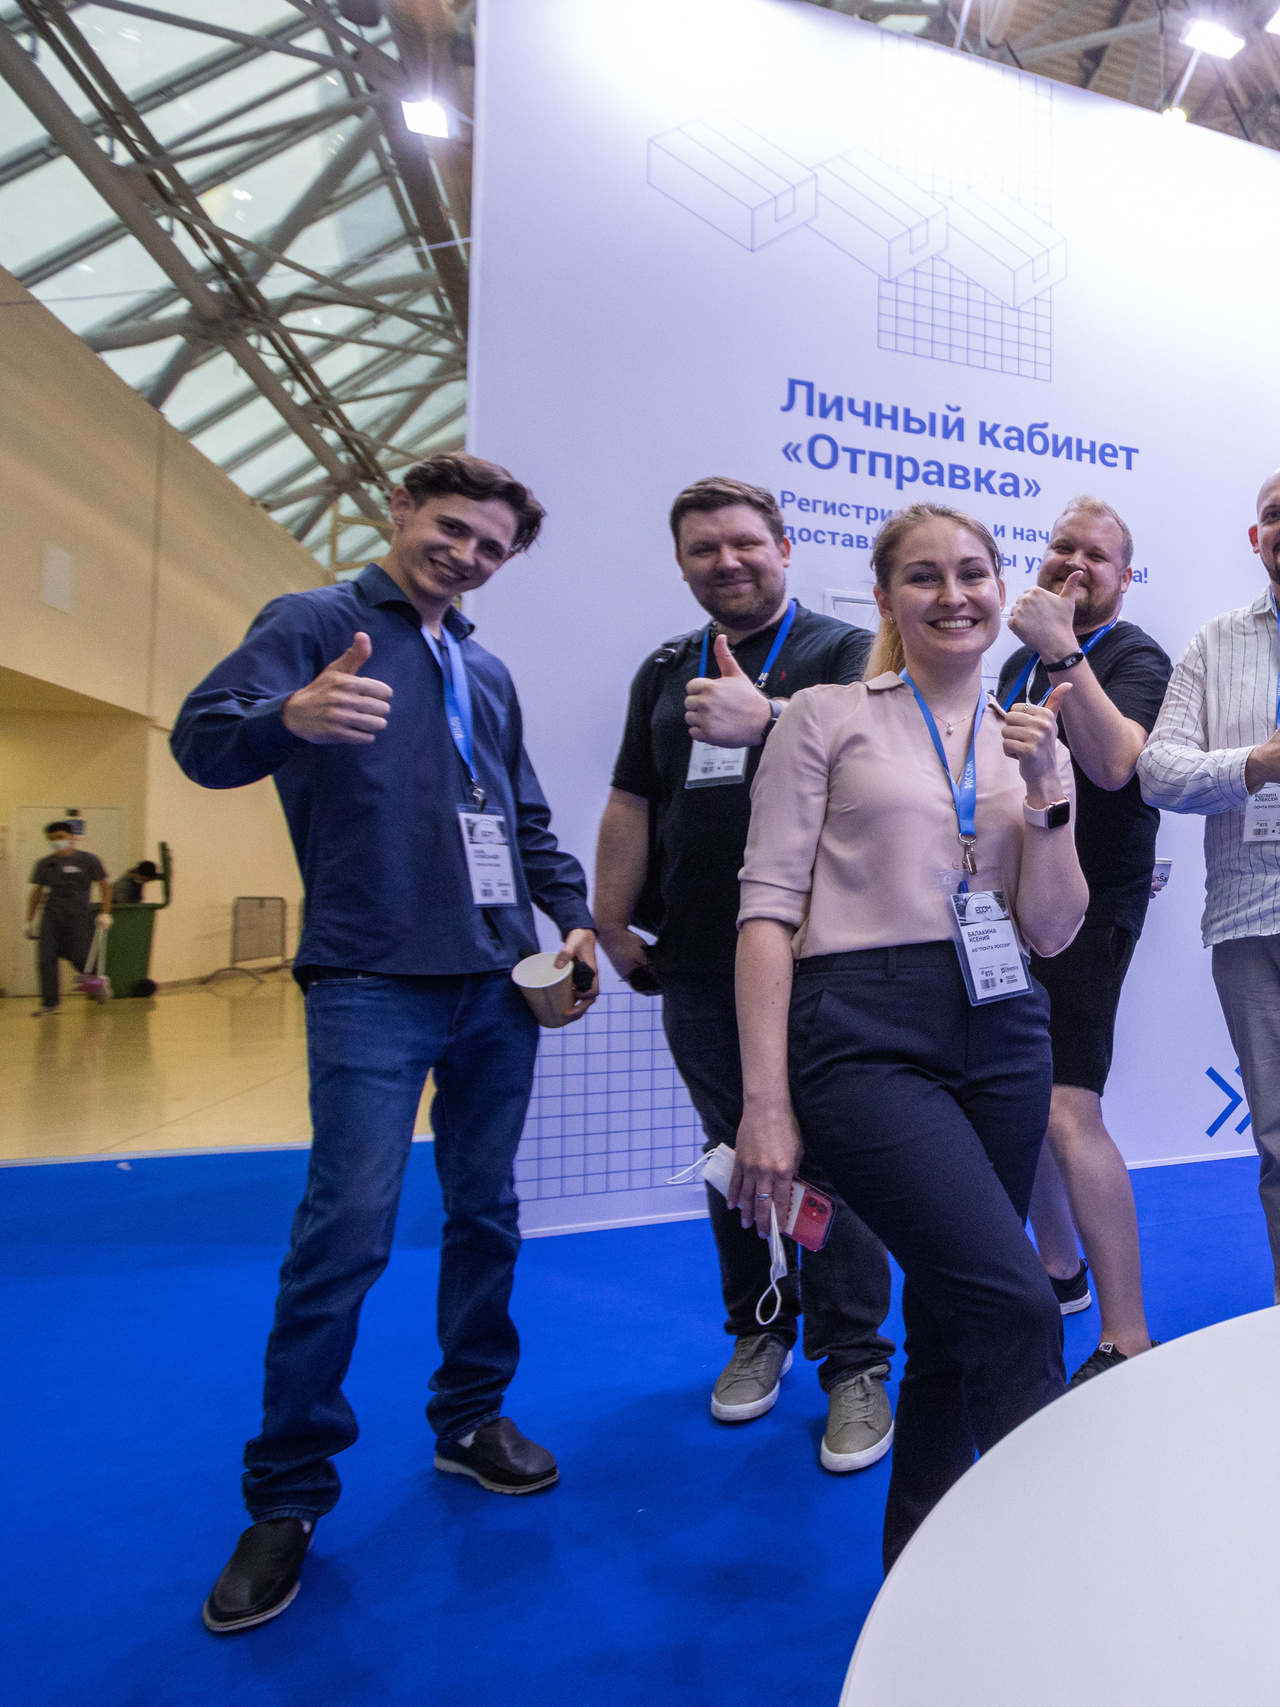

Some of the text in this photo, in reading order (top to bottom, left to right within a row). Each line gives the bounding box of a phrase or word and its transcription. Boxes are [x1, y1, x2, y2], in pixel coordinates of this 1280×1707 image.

[780, 377, 1139, 471] Личный кабинет
[780, 432, 1041, 499] «Отправка»
[993, 524, 1005, 538] и
[964, 760, 974, 789] РОССИИ
[967, 928, 997, 937] БАЛАКИНА
[969, 935, 990, 943] КСЕНИЯ
